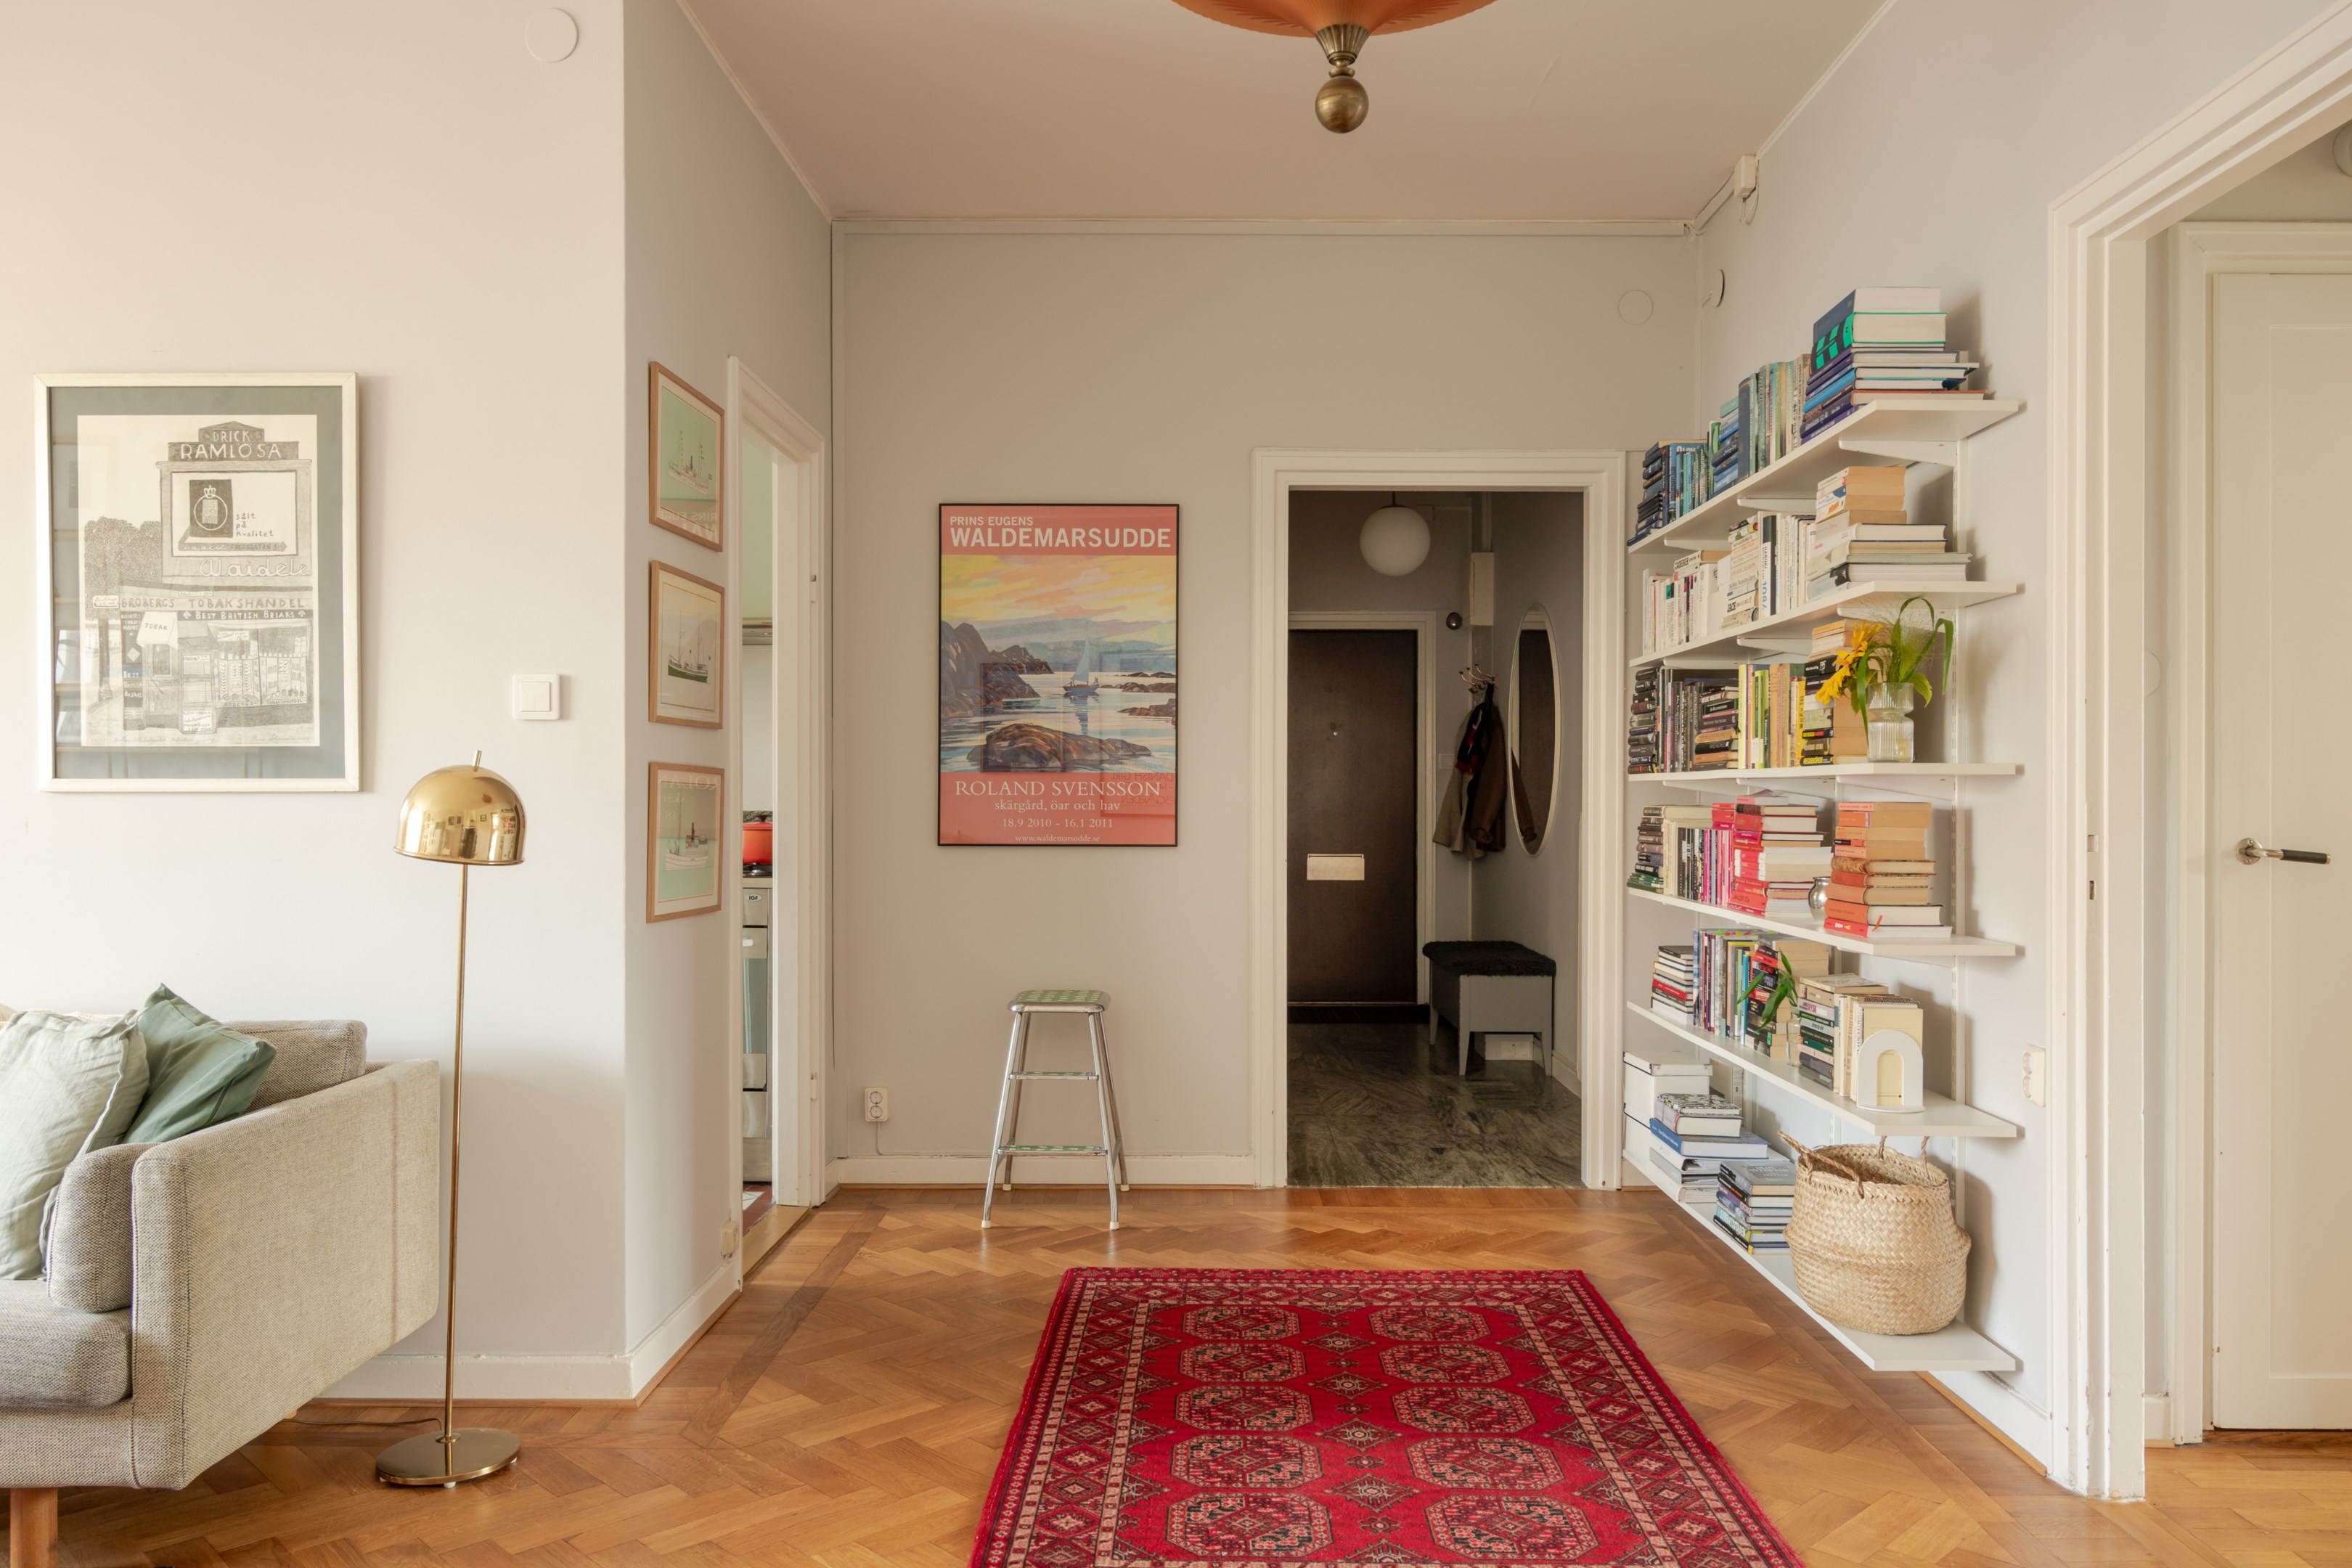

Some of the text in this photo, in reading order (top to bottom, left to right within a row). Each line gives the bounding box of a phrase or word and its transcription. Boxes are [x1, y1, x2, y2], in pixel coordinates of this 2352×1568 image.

[213, 430, 250, 442] DRICK
[180, 442, 282, 460] RAMLÖSA
[950, 516, 1034, 526] PRINS EUGENS
[950, 528, 1171, 548] WALDEMARSUDDE
[200, 558, 311, 577] Waidele
[121, 597, 175, 608] BROBERGS
[264, 610, 295, 618] BRIARS
[955, 780, 1045, 796] ROLAND
[1051, 780, 1161, 796] SVENSSON
[995, 799, 1121, 814] skärgård, öar och hav
[1002, 818, 1024, 828] 18.9
[1027, 818, 1053, 828] 2010
[1064, 818, 1085, 828] 16.1
[1089, 818, 1114, 828] 2011
